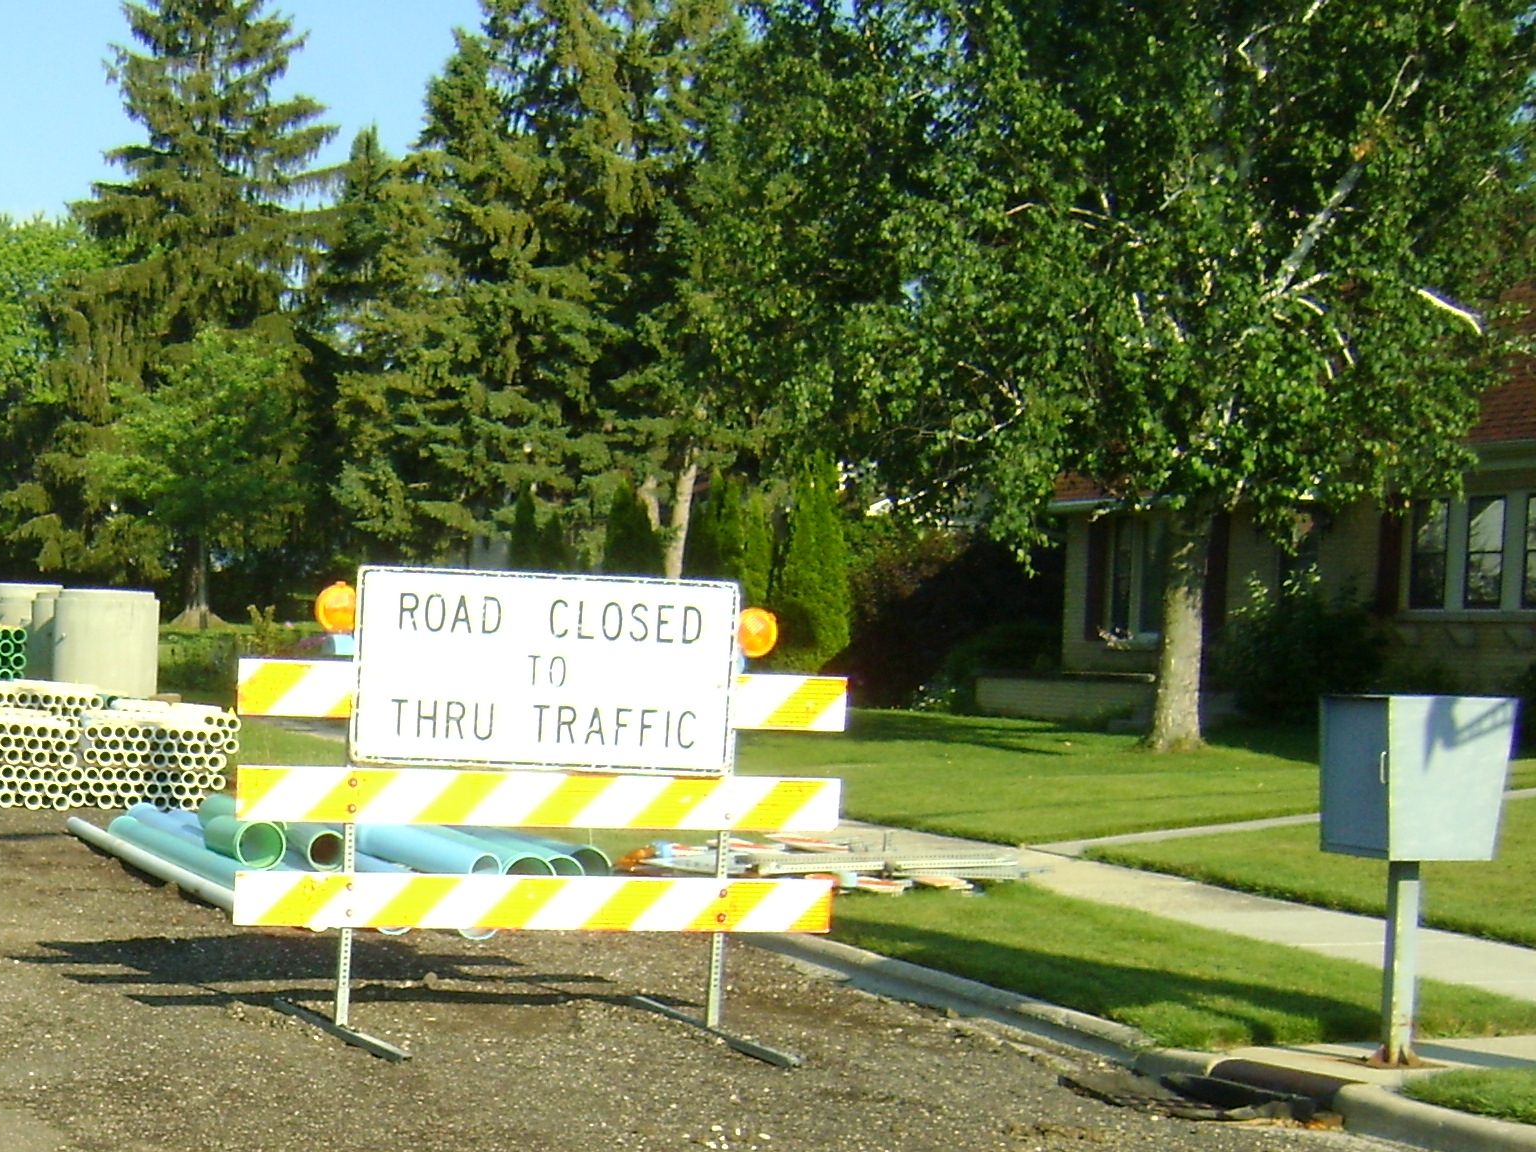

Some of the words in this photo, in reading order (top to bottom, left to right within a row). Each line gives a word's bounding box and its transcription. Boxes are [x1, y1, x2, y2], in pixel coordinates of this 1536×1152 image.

[398, 592, 502, 635] ROAD
[549, 599, 702, 645] CLOSED
[527, 654, 567, 688] TO
[391, 698, 495, 741] THRU
[532, 704, 697, 750] TRAFFIC
